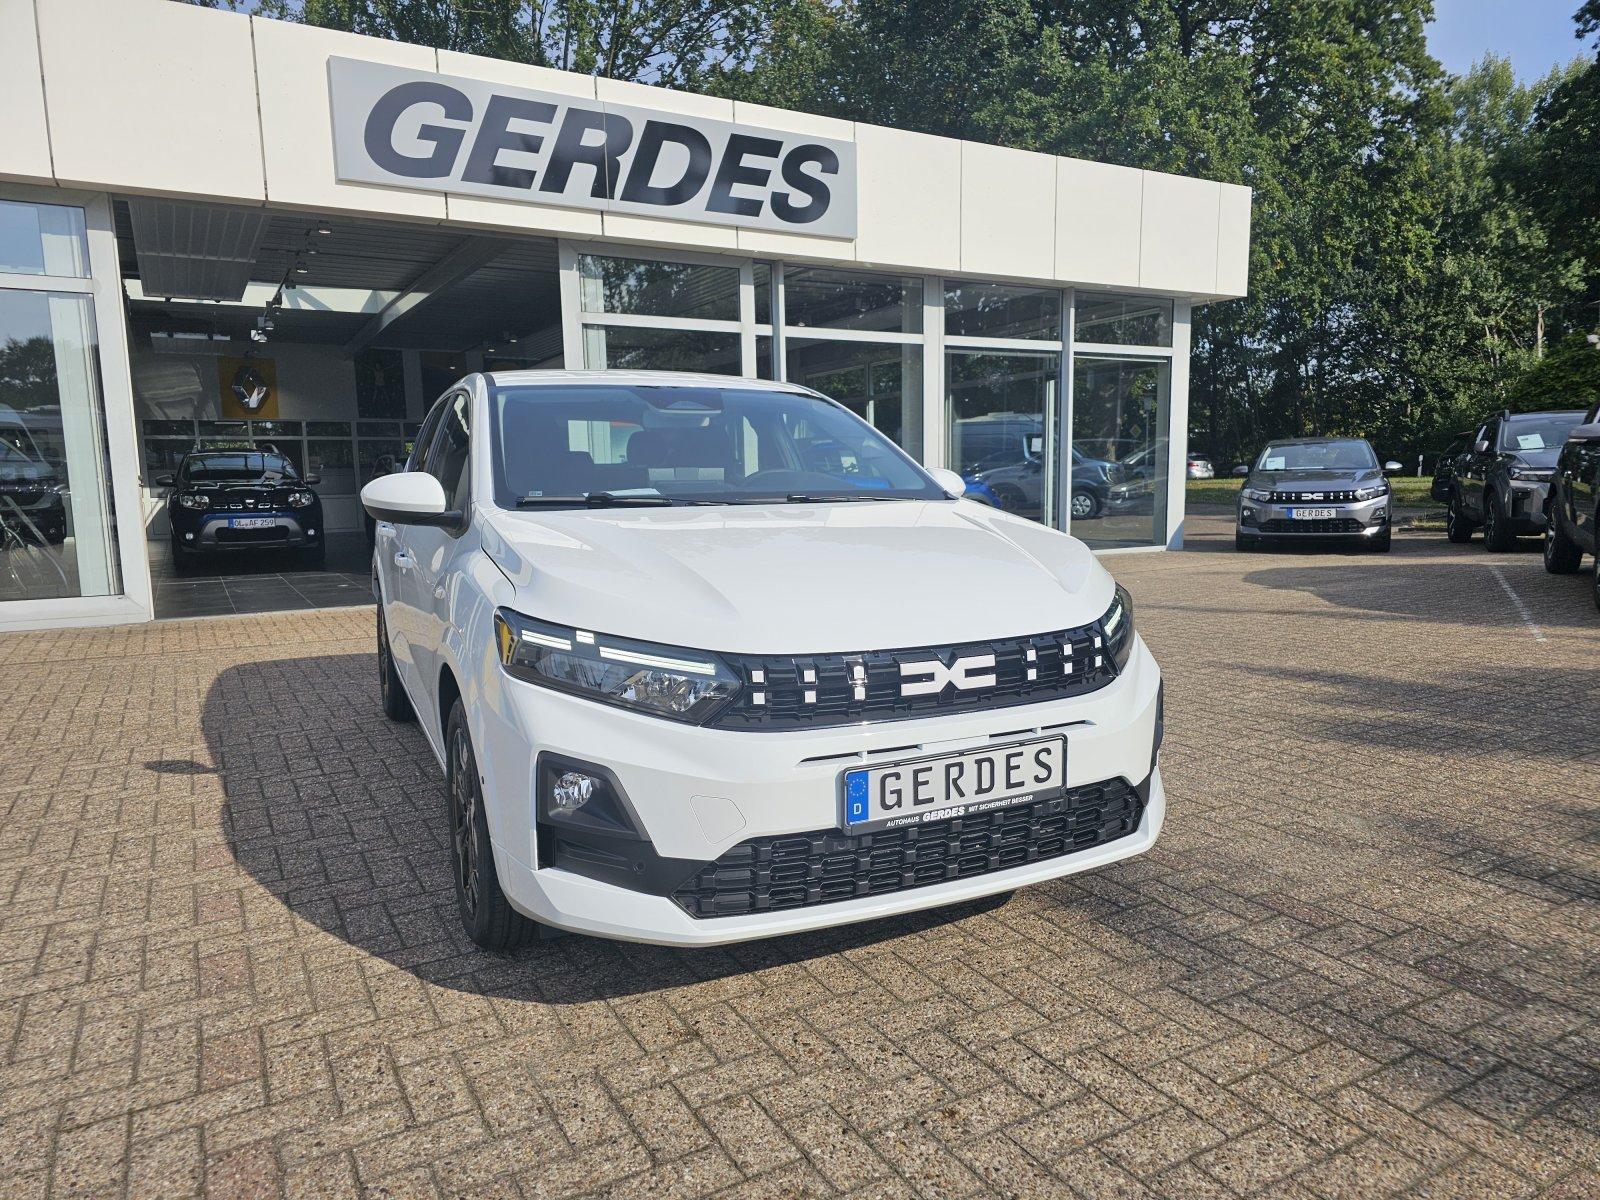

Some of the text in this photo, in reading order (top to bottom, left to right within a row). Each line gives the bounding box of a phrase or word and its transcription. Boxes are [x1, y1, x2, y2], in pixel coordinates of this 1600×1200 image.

[363, 81, 839, 224] GERDES
[1296, 509, 1333, 517] GERDES
[879, 747, 1053, 811] GERDES
[853, 803, 862, 815] D
[886, 794, 1034, 828] AUTOHAUS GERDES MIT SICHERHEIT BESSER
